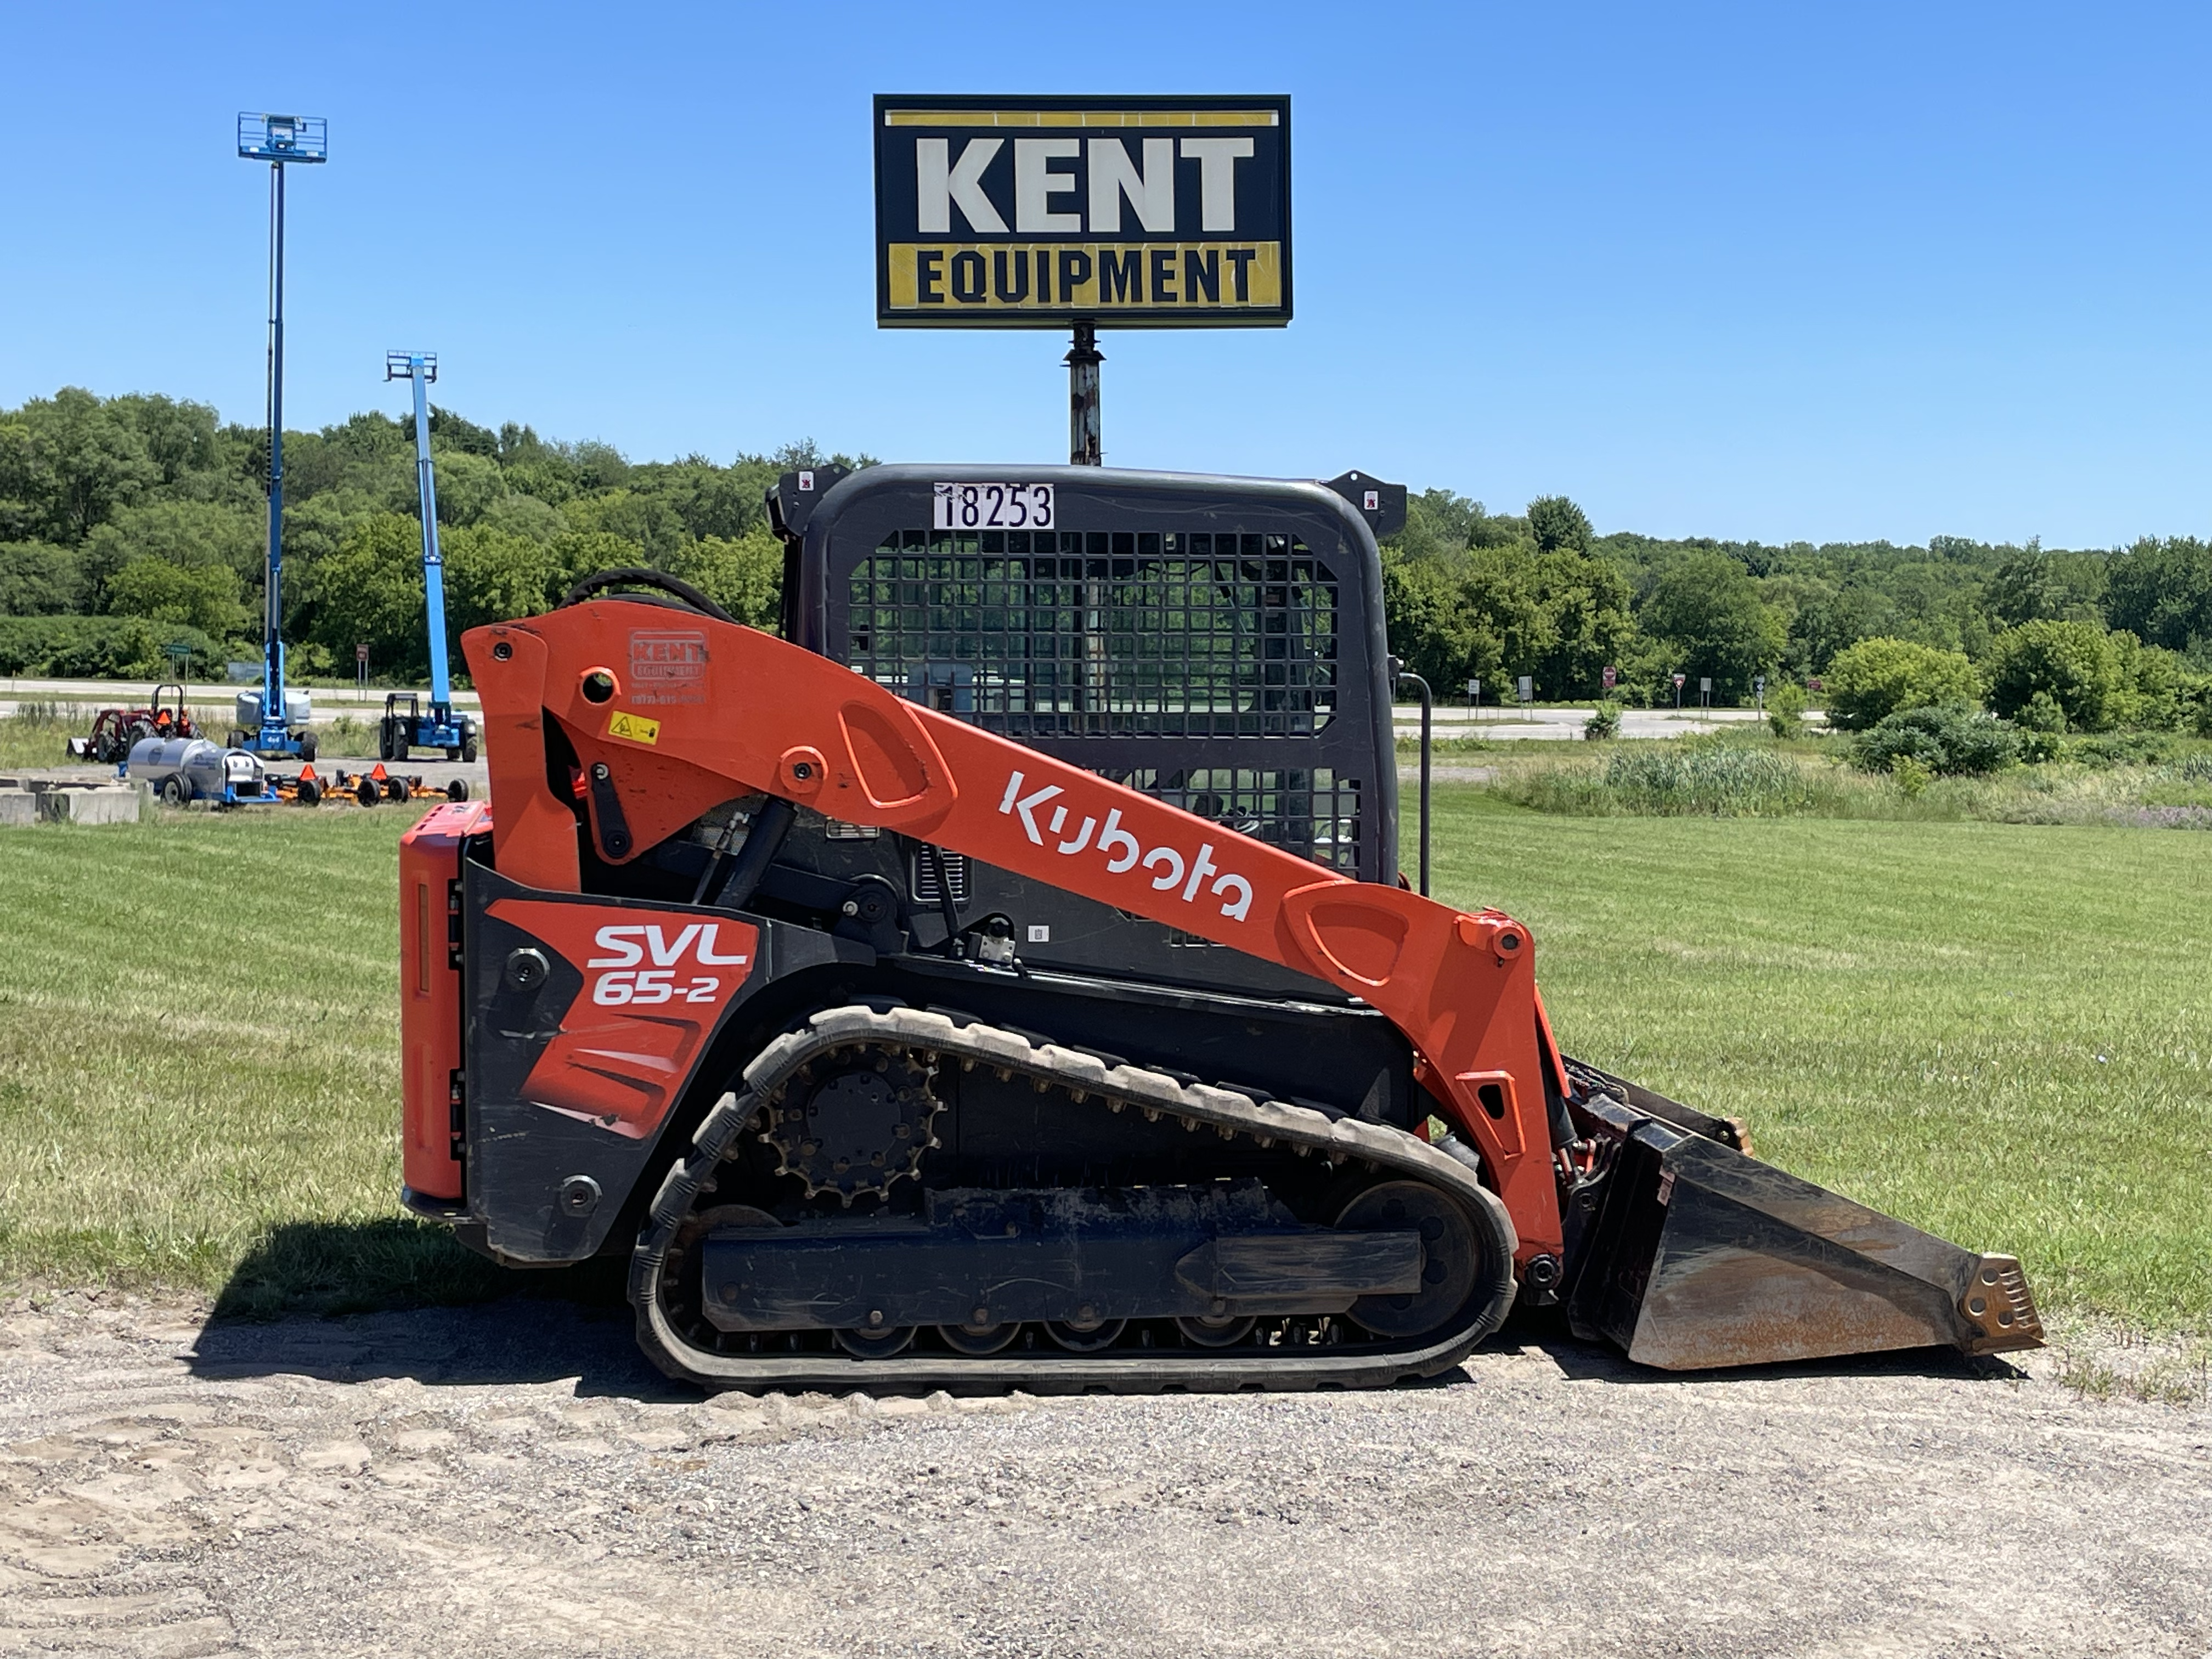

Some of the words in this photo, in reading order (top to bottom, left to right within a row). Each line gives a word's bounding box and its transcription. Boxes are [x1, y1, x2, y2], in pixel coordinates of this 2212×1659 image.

[916, 137, 1255, 233] KENT
[917, 250, 1255, 303] EQUIPMENT
[938, 486, 1051, 527] 18253
[634, 643, 702, 661] KENT
[998, 770, 1253, 922] Kubota
[587, 923, 748, 968] SVL
[592, 970, 720, 1005] 65-2
